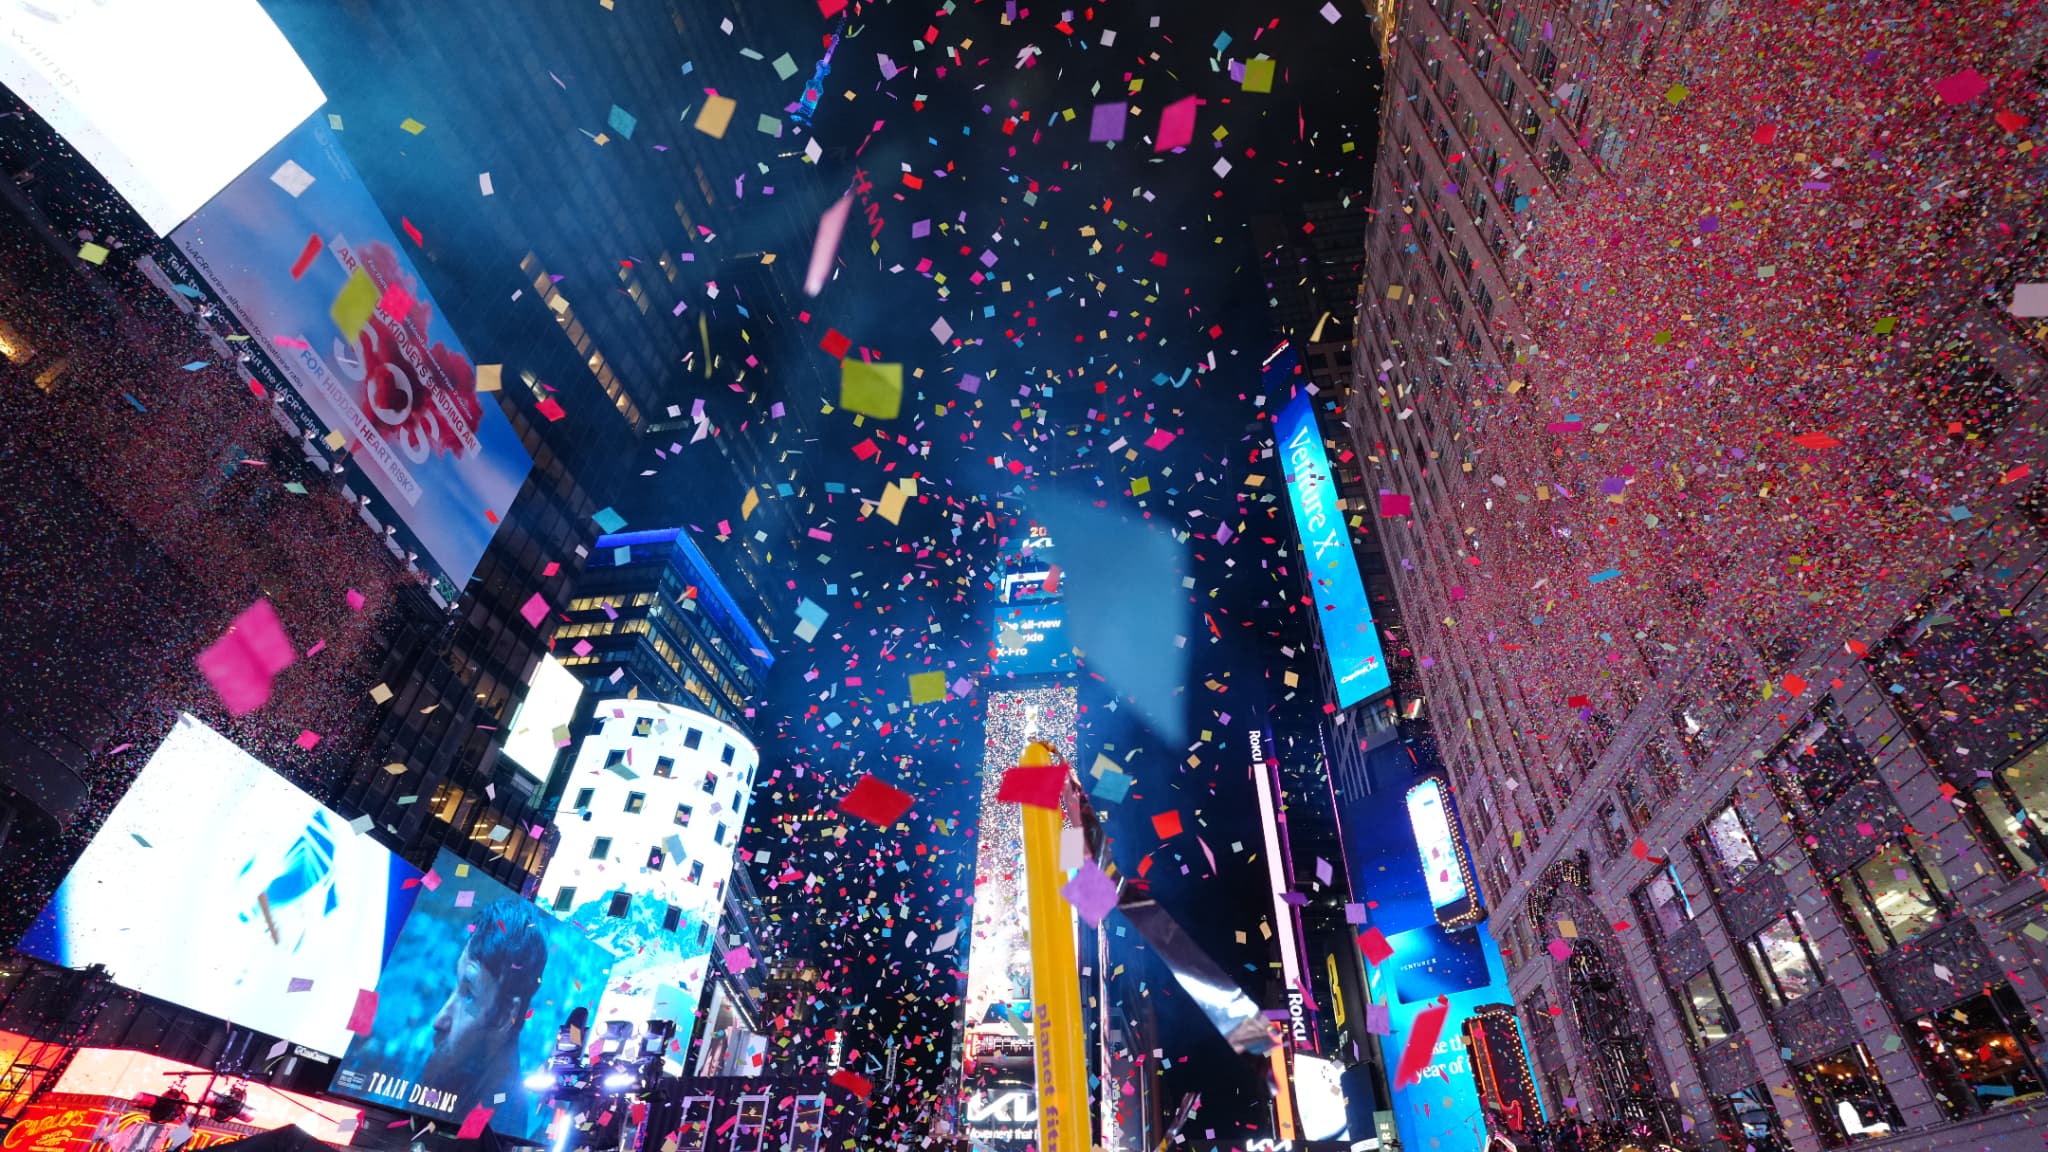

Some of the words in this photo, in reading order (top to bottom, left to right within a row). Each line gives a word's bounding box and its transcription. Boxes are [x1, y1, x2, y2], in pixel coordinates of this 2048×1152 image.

[167, 255, 186, 280] Talk
[260, 364, 278, 385] the
[301, 349, 325, 380] FOR
[324, 378, 362, 426] HIDDEN
[360, 424, 390, 462] HEART
[389, 463, 415, 493] RISK?
[334, 320, 439, 464] SOS
[388, 321, 427, 376] KIDNEYS
[425, 378, 465, 432] SENDING
[1289, 426, 1326, 533] Venture
[1313, 528, 1340, 560] X
[1021, 619, 1061, 629] all-new
[368, 1071, 409, 1100] TRAIN
[1036, 1003, 1055, 1097] planet
[1449, 1055, 1465, 1075] of
[1015, 1127, 1033, 1140] that
